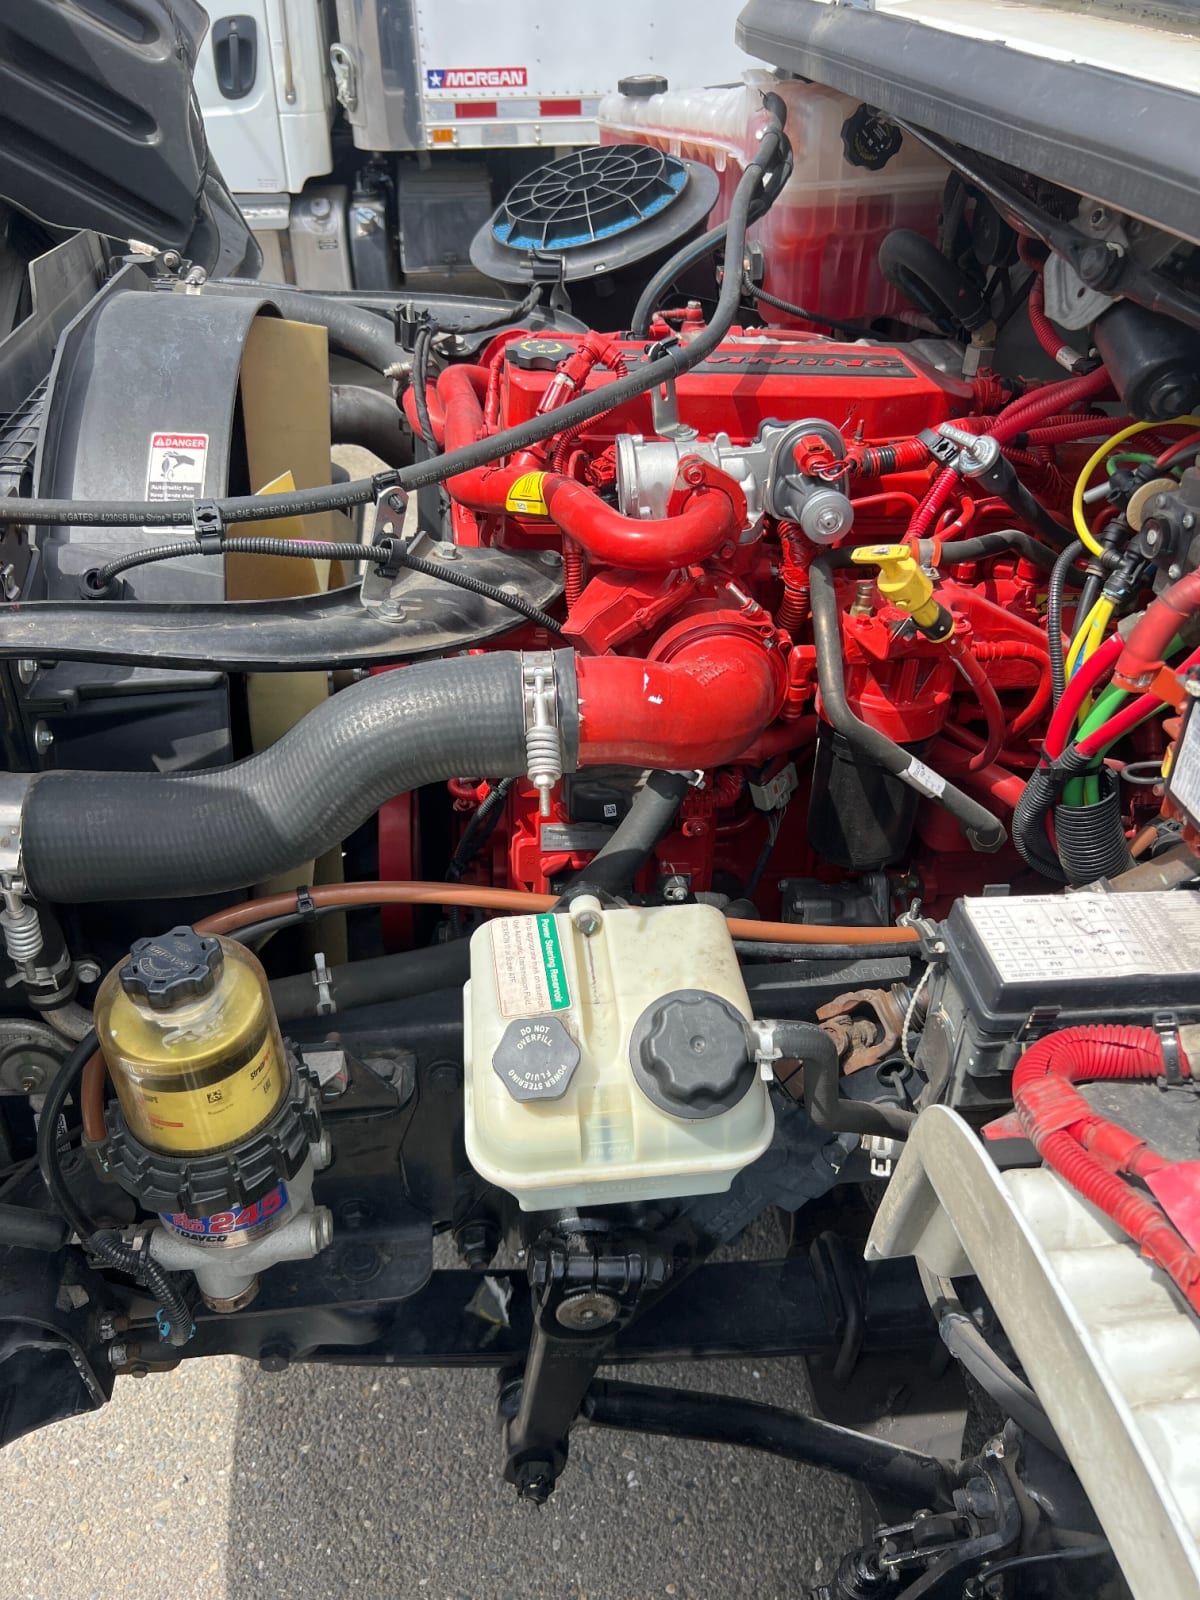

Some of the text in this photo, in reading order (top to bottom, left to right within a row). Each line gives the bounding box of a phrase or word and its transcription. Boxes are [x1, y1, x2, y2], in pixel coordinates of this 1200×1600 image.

[446, 71, 524, 86] MORGAN
[165, 439, 204, 448] DANGER
[129, 513, 145, 521] Blue
[541, 918, 562, 1002] Power Steering Reservoir
[520, 1025, 550, 1036] DO NOT
[516, 1034, 552, 1050] OVERFILL
[508, 1064, 567, 1091] POWER STEERING
[525, 1070, 552, 1081] FLUID
[209, 1189, 283, 1233] 245
[180, 1231, 228, 1242] DAVCO
